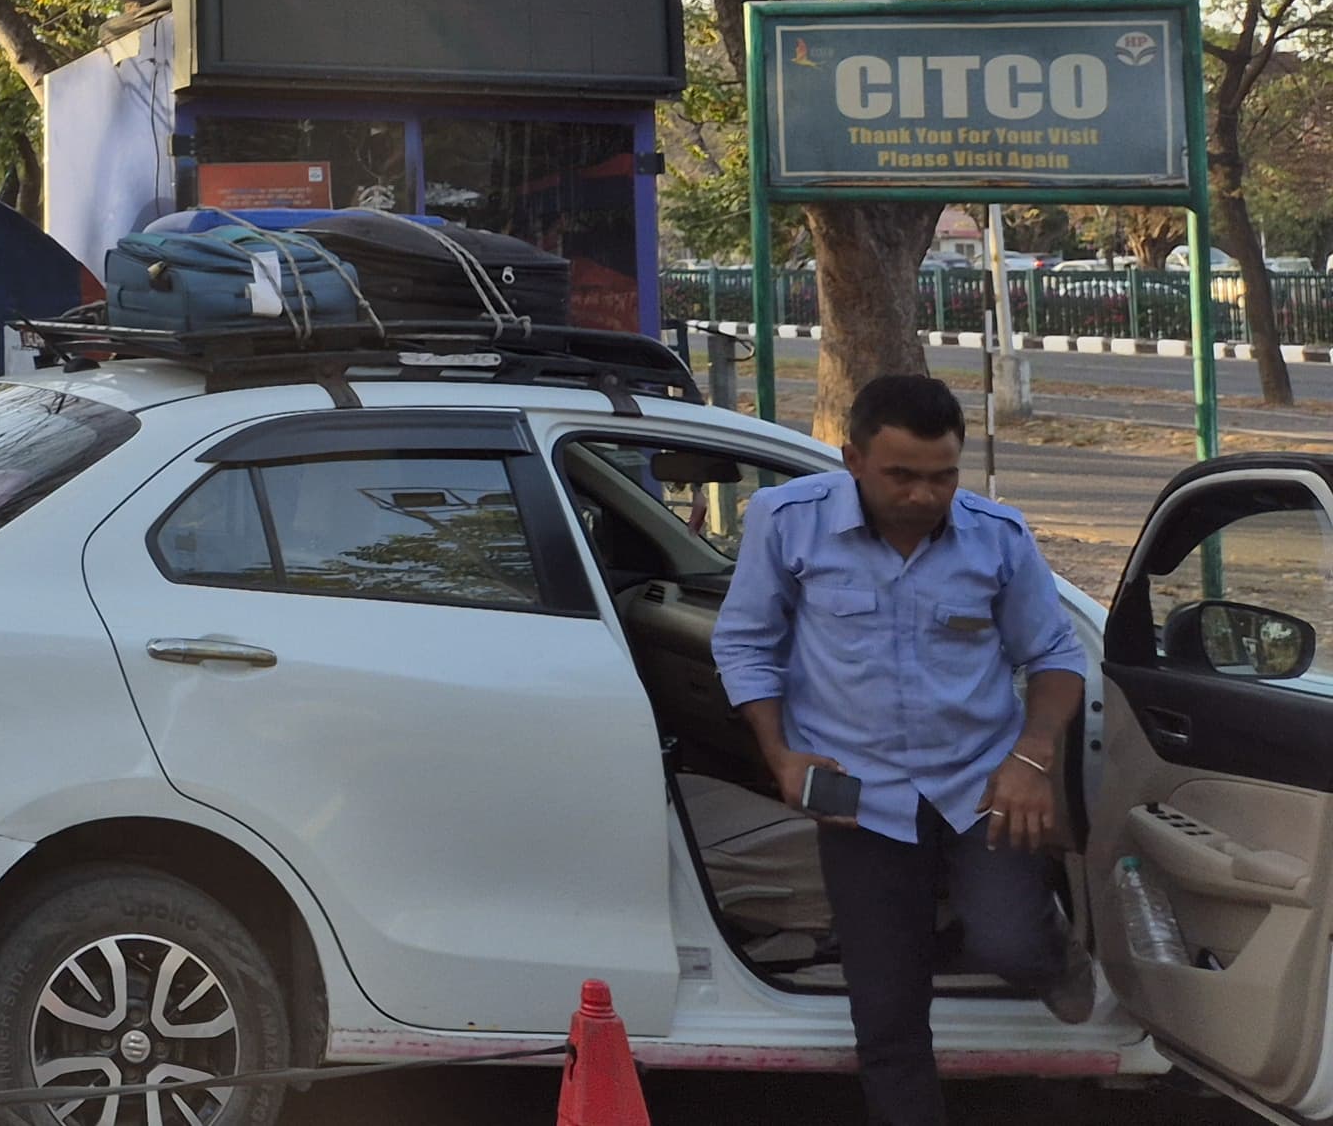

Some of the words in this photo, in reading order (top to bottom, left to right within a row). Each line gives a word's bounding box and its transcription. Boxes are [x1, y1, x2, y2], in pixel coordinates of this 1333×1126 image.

[1125, 37, 1148, 48] HP
[835, 54, 1108, 119] CITCO
[848, 127, 911, 144] Thank
[915, 128, 953, 144] You
[958, 127, 990, 143] For
[995, 128, 1044, 144] Your
[1048, 128, 1097, 144] Visit
[878, 151, 949, 167] Please
[953, 151, 1003, 166] Visit
[1008, 151, 1068, 169] Again
